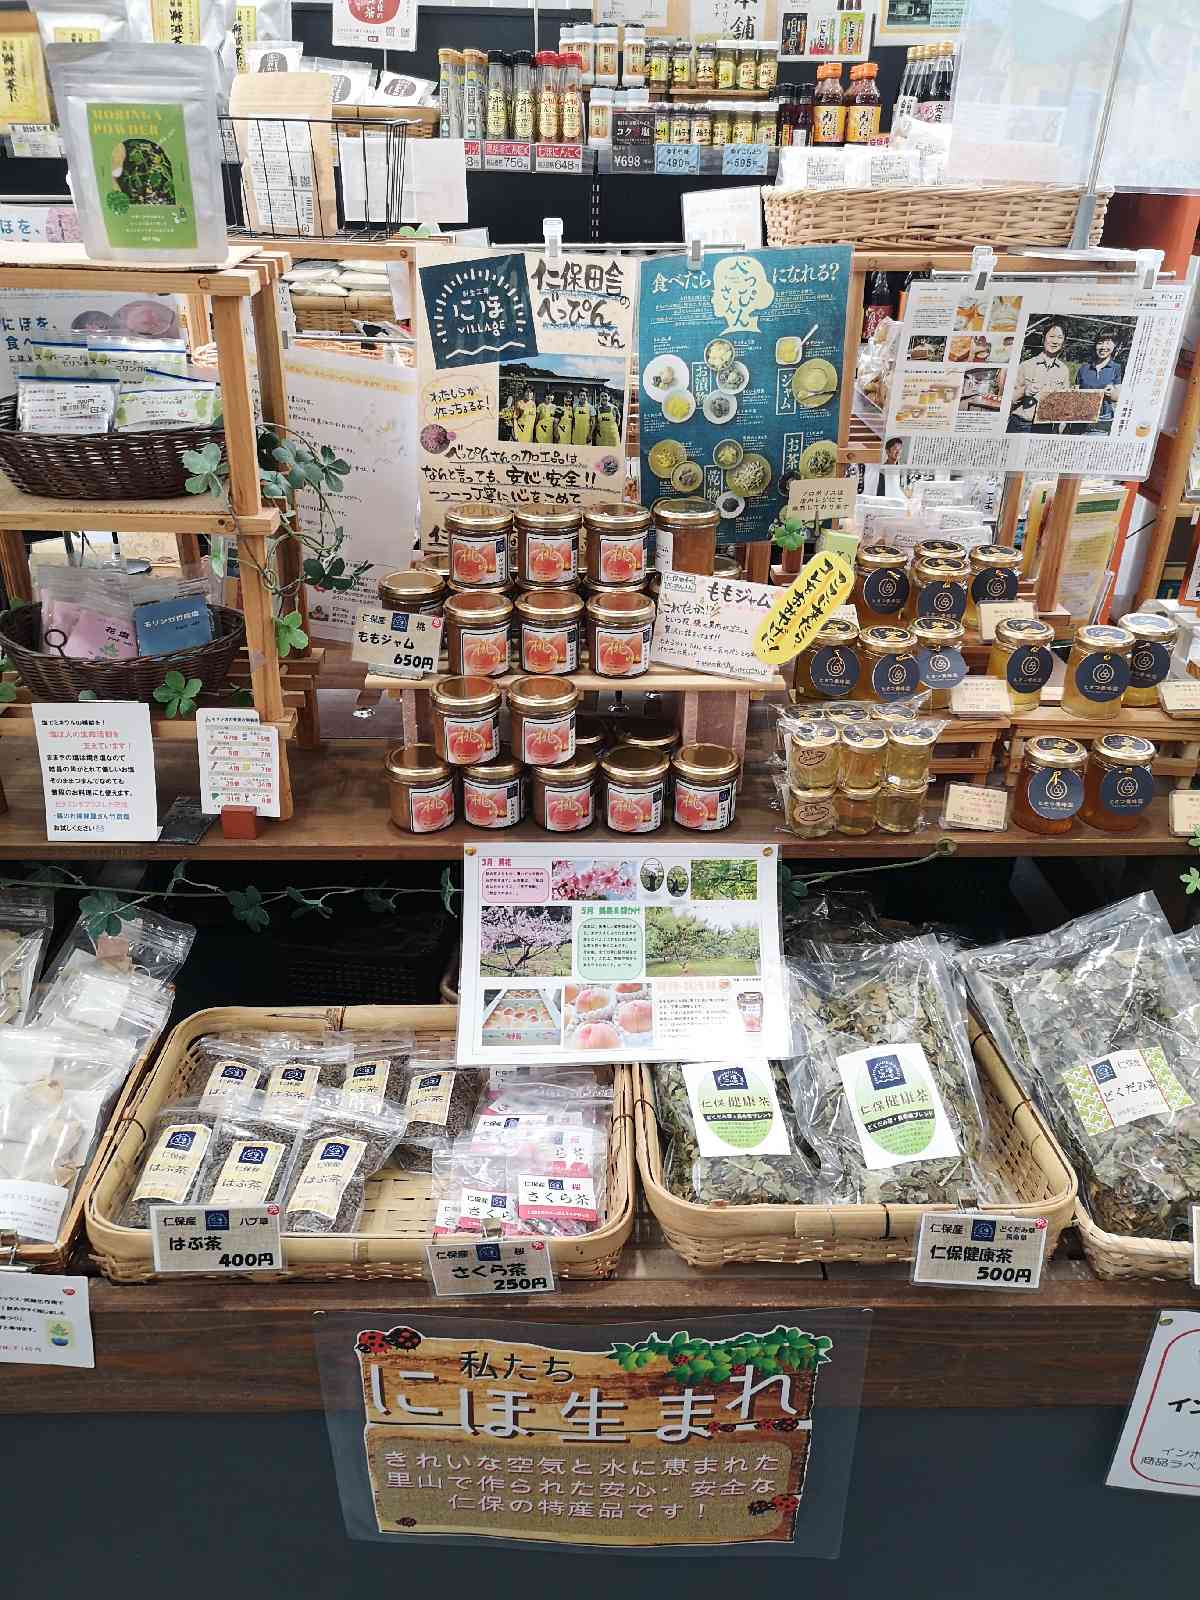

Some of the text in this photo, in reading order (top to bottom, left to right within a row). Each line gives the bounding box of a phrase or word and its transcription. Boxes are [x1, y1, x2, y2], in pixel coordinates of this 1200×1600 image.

[652, 270, 712, 294] 食べたら
[536, 291, 614, 327] べっぴん
[598, 331, 626, 349] さん
[707, 581, 771, 608] ももジャム
[362, 614, 387, 625] 仁保産
[358, 631, 415, 650] ももジャム
[393, 653, 434, 671] 650円
[1104, 1081, 1160, 1103] どくだみ茶
[702, 1094, 771, 1110] 仁保健康茶
[860, 1089, 930, 1116] 仁保健康茶
[527, 1192, 591, 1206] さくら茶
[163, 1216, 197, 1227] 仁保産
[930, 1223, 964, 1234] 仁保産
[168, 1236, 223, 1252] はぶ茶
[218, 1252, 274, 1267] 400円
[436, 1250, 469, 1260] 仁保産
[930, 1244, 1013, 1264] 仁保健康茶
[452, 1263, 527, 1279] さくら茶
[976, 1266, 1032, 1283] 500円
[494, 1277, 548, 1291] 250円
[460, 1349, 575, 1384] 私たち
[370, 1363, 799, 1444] にほ生まれ
[383, 1450, 780, 1475] きれいな空気と水に恵まれた
